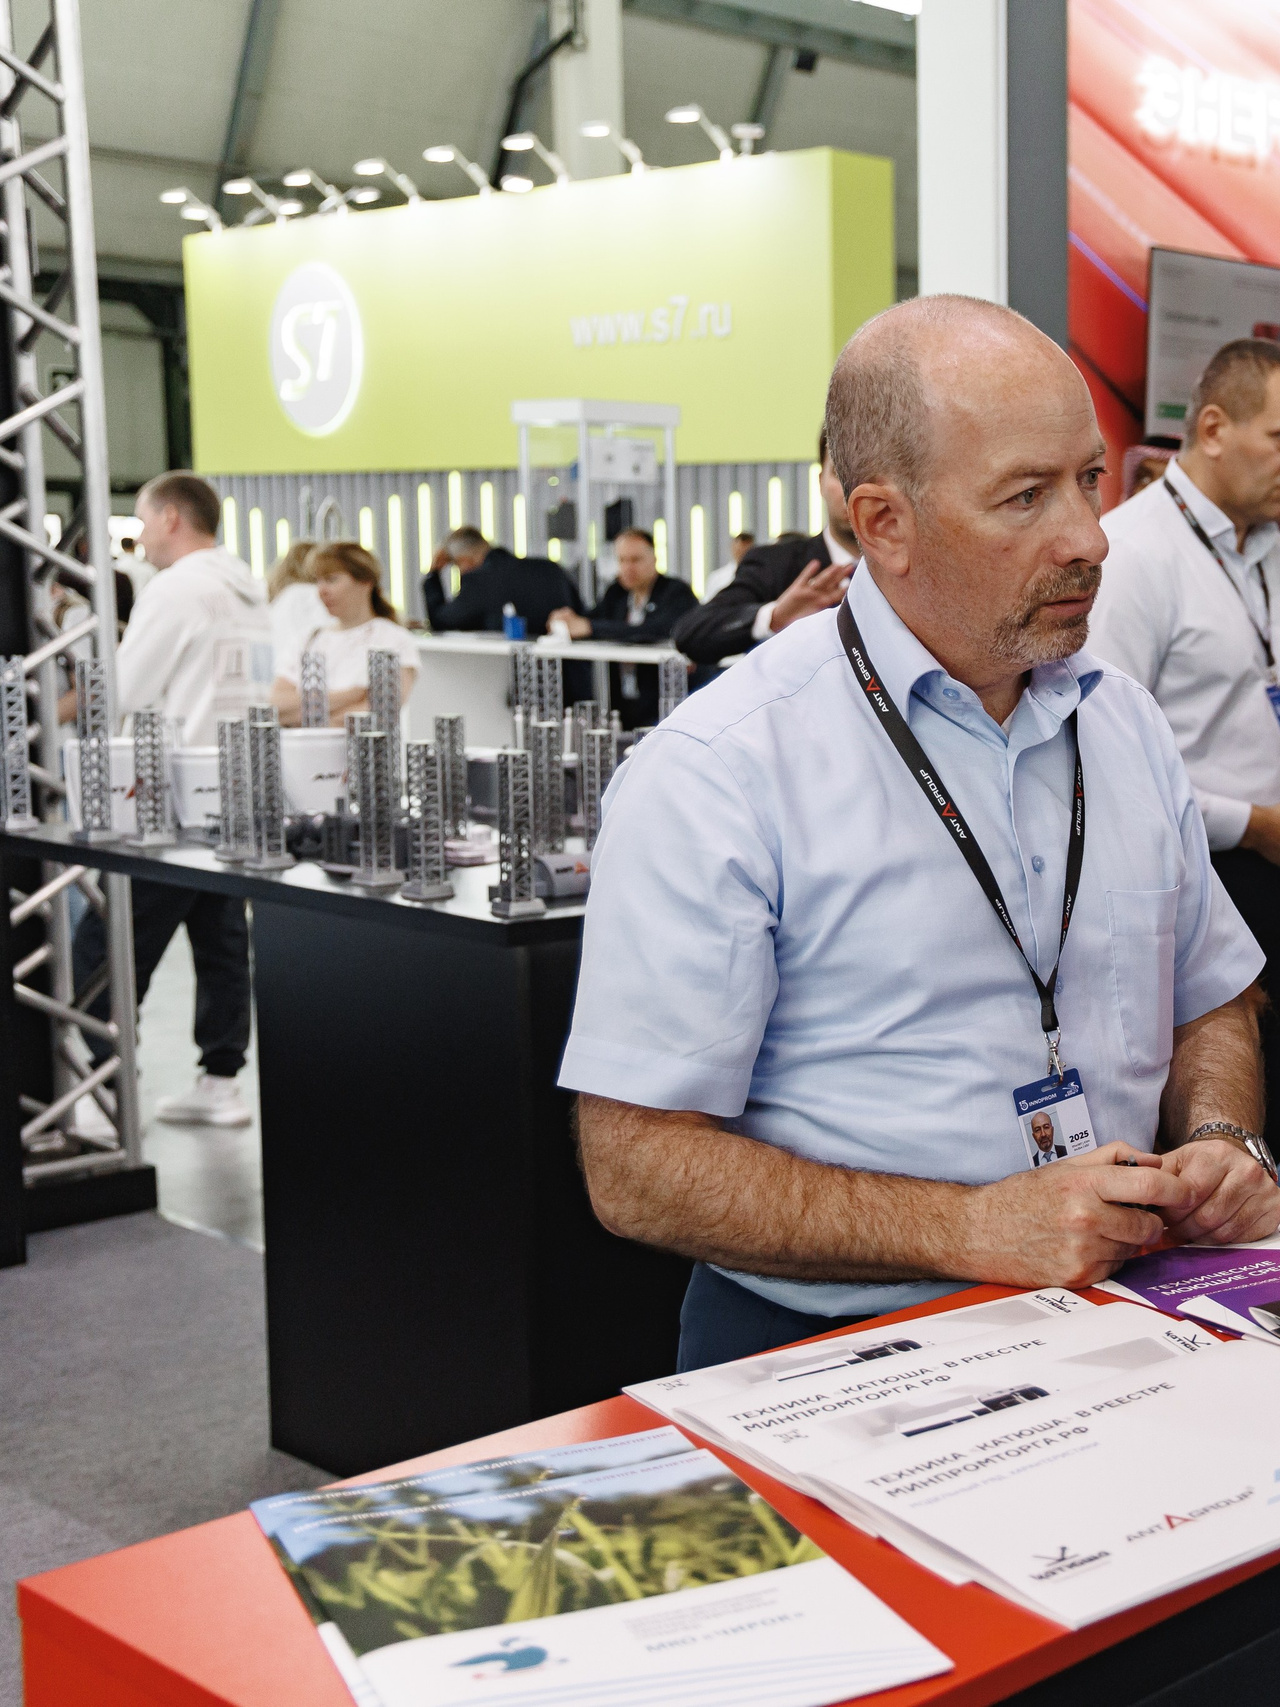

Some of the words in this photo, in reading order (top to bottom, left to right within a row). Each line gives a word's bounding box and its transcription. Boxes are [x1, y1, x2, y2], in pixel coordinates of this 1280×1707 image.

[569, 295, 732, 348] www.s7.ru
[280, 300, 345, 401] S7
[851, 647, 872, 681] GROUP
[873, 692, 889, 713] ANT
[919, 768, 947, 806] GROUP
[949, 817, 967, 840] ANT
[1069, 1129, 1090, 1143] 2025
[1147, 1260, 1276, 1291] ТЕХНИЧЕСКИЕ
[1161, 1273, 1249, 1297] МОЮЩИЕ
[728, 1392, 829, 1422] ТЕХНИКА
[944, 1358, 960, 1369] В
[961, 1338, 1047, 1364] РЕЕСТРЕ
[742, 1383, 919, 1432] МИНПРОМТОРГА
[922, 1373, 952, 1387] РФ
[866, 1451, 968, 1488] ТЕХНИКА
[1074, 1409, 1092, 1419] В
[1092, 1382, 1176, 1412] РЕЕСТРЕ
[886, 1437, 1057, 1498] МИНПРОМТОРГА
[1058, 1423, 1090, 1440] РФ
